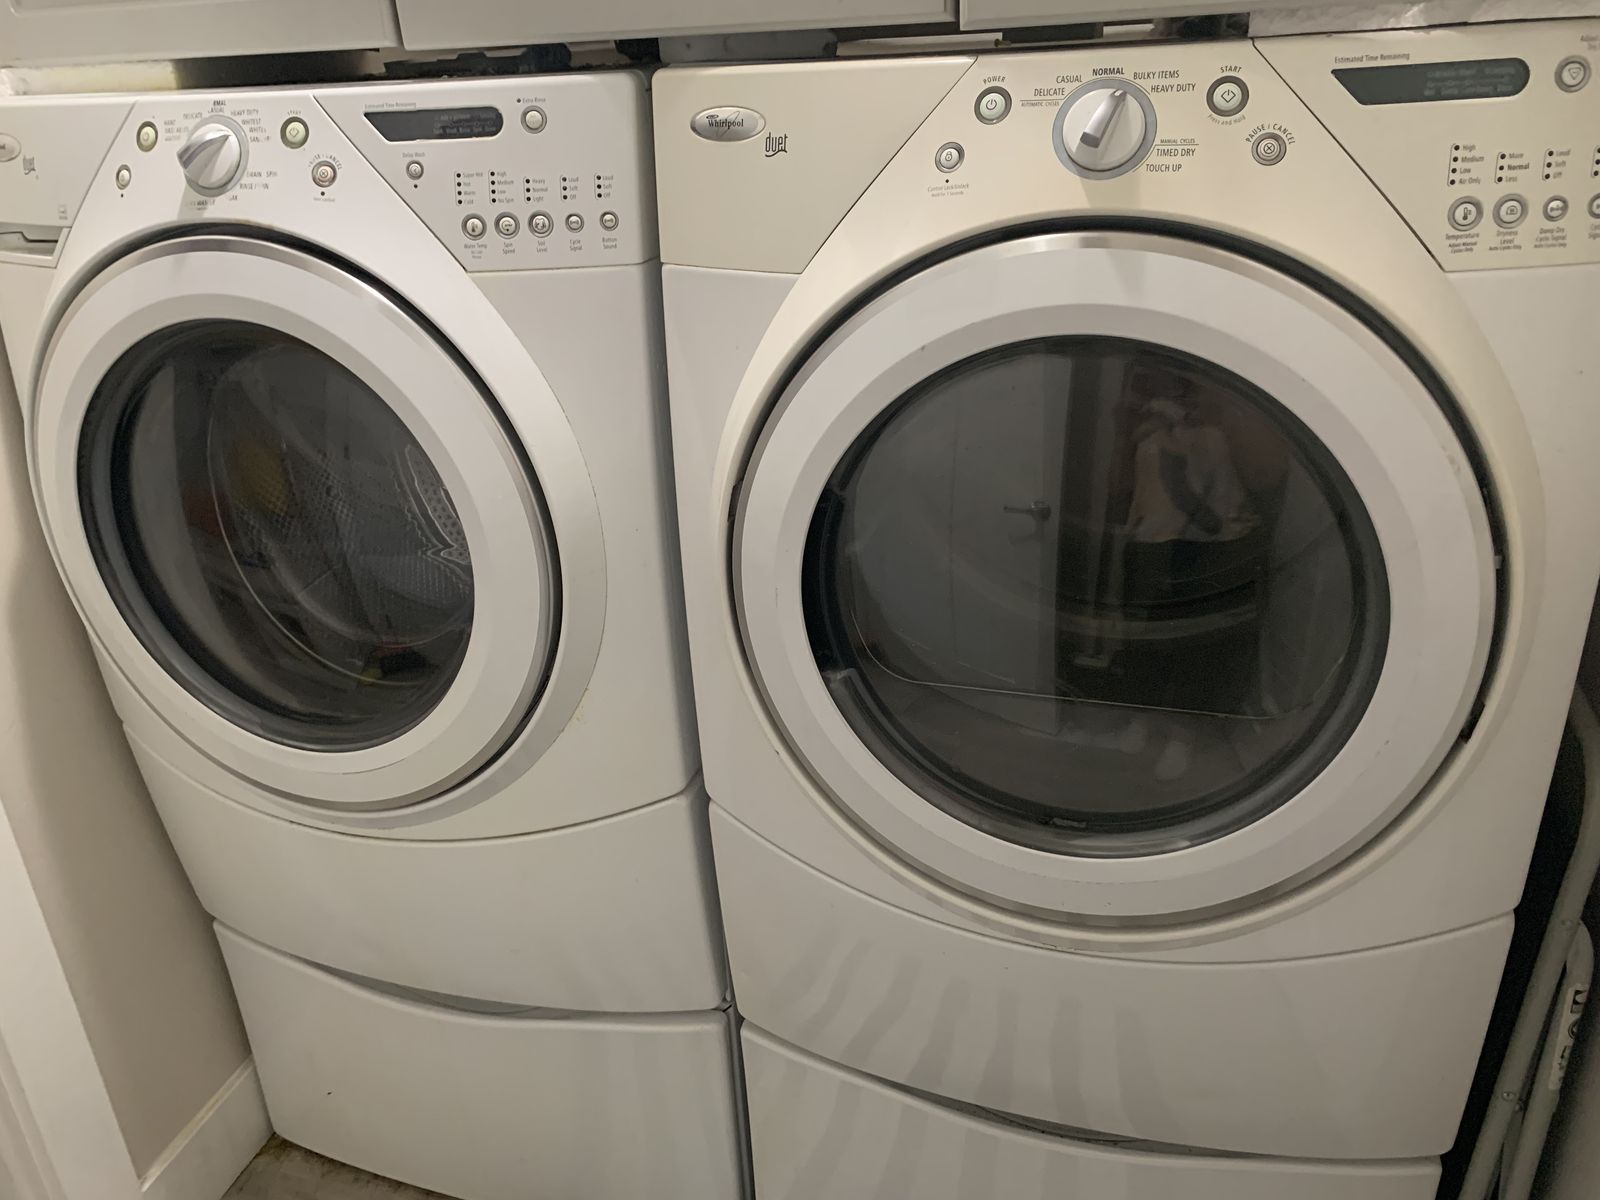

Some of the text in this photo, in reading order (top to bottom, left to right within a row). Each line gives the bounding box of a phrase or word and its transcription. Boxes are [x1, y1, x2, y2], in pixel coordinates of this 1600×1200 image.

[1334, 55, 1364, 64] Estimated
[1365, 54, 1379, 62] Time
[1092, 67, 1125, 77] NORMAL
[1220, 65, 1242, 74] START
[983, 75, 1006, 85] POWER
[1056, 75, 1083, 84] CASUAL
[1133, 70, 1180, 80] BULKY ITEMS
[1033, 87, 1066, 97] DELICATE
[1151, 83, 1196, 93] HEAVY DUTY
[707, 118, 744, 130] Whirlpool
[1245, 123, 1265, 144] PAUSE
[1272, 123, 1296, 145] CANCEL
[764, 132, 789, 157] duet
[1462, 144, 1476, 152] High
[1156, 148, 1196, 158] TIMED DRY
[1145, 163, 1183, 173] TOUCH UP
[1507, 163, 1530, 171] Normal
[1445, 233, 1480, 241] Temperature
